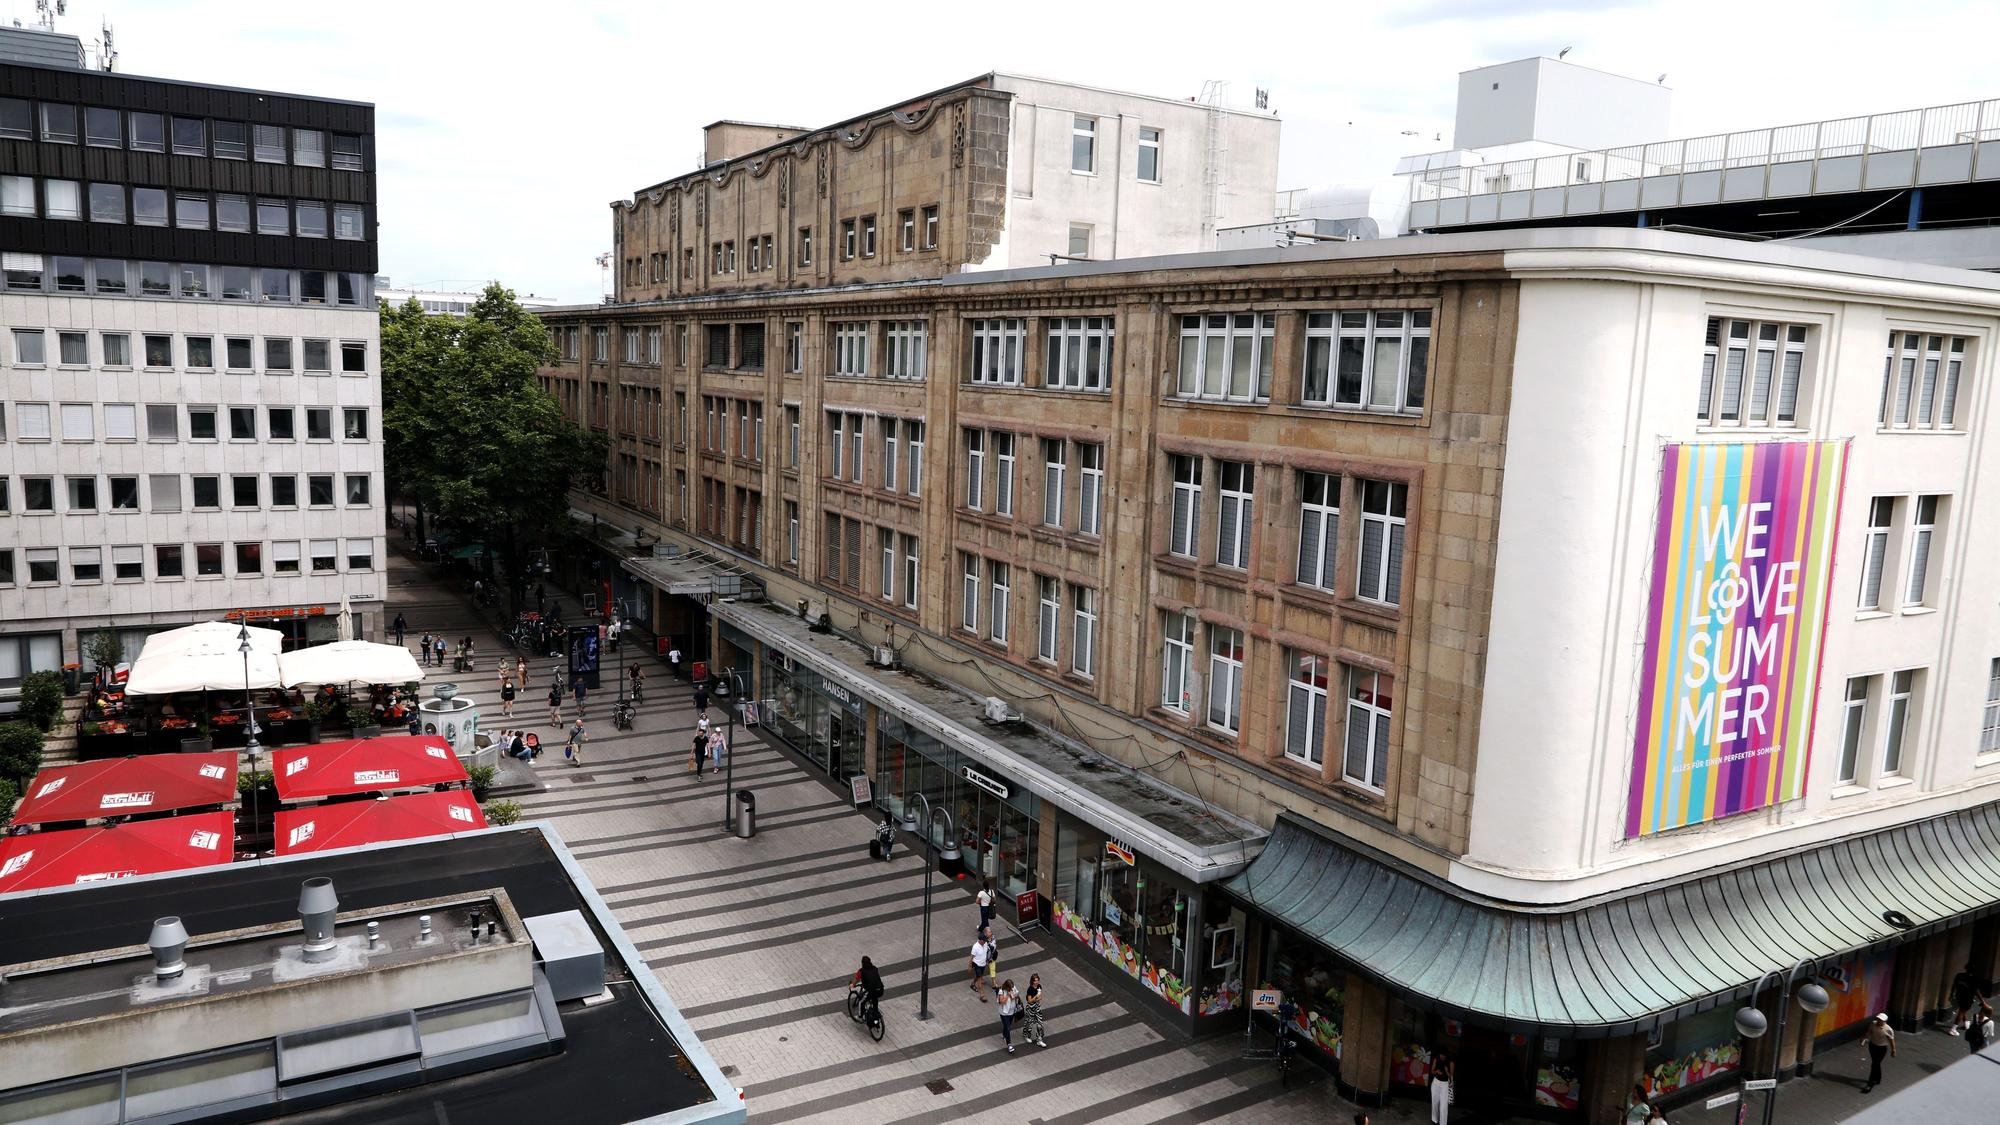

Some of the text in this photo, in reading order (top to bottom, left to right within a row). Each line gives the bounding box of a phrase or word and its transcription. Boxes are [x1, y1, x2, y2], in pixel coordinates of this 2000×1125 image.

[1700, 502, 1771, 562] WE
[1690, 561, 1800, 626] LOVE
[1683, 622, 1778, 689] SUM
[822, 677, 850, 703] HANSEN
[1676, 684, 1770, 751] MER
[969, 772, 977, 781] LE
[1672, 745, 1782, 773] ALLES FÜR EINEN PERFEKTEN SOMMER
[1259, 993, 1274, 1002] dm
